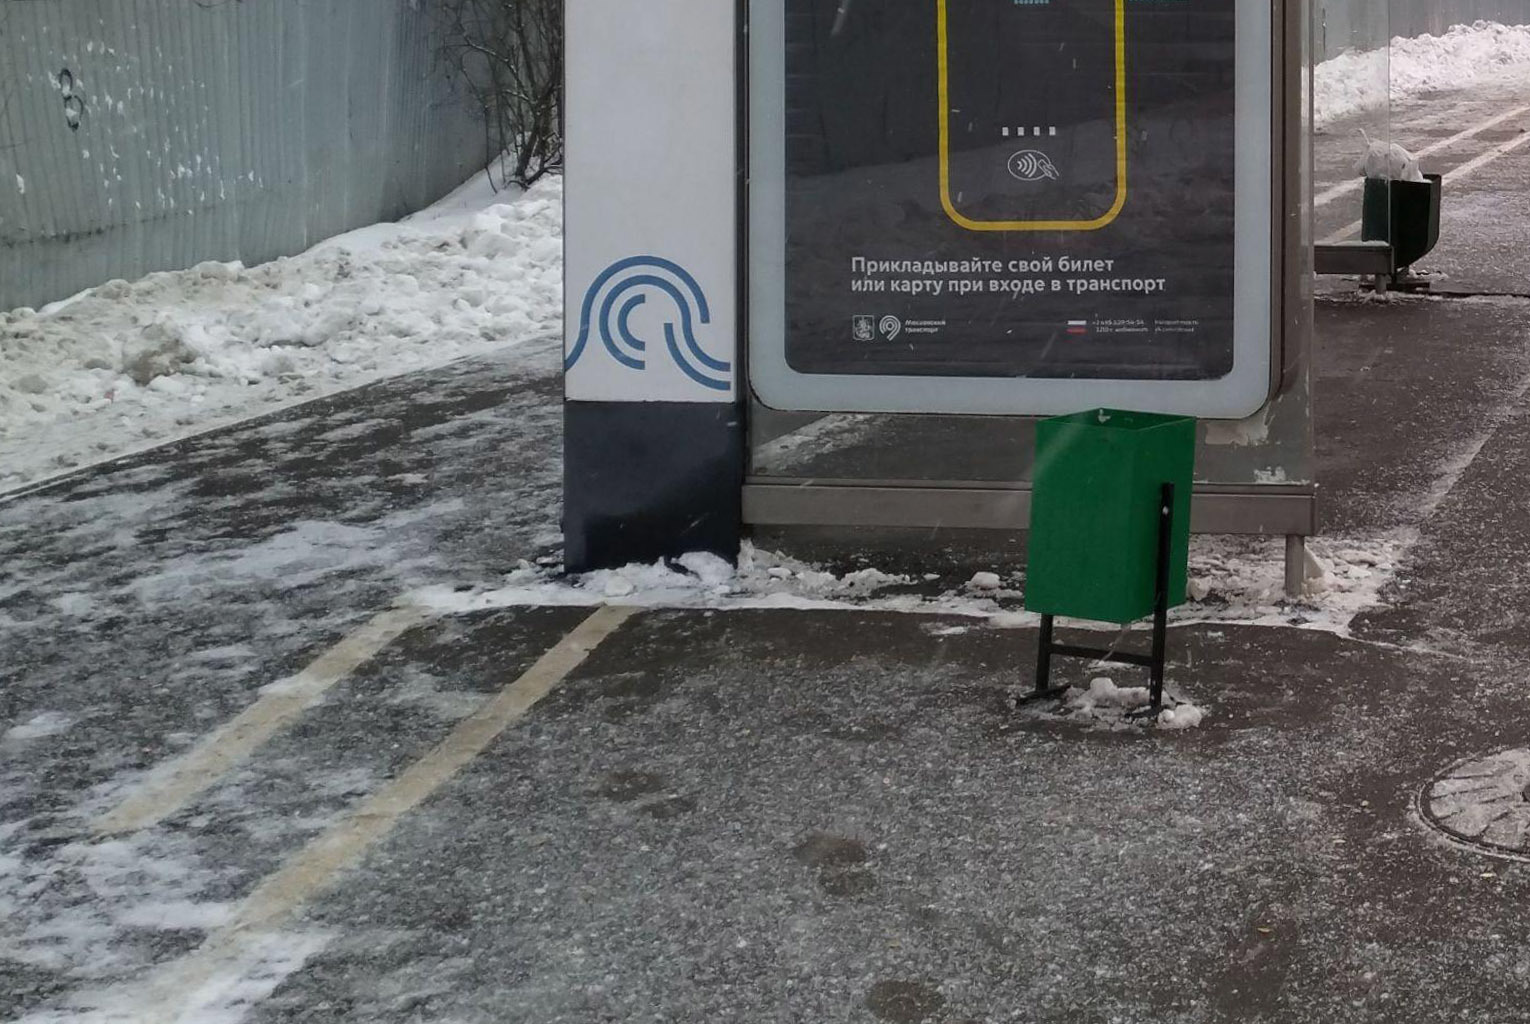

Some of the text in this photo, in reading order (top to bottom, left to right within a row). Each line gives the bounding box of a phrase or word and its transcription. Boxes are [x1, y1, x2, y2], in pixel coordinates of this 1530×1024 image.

[851, 256, 1114, 276] Прикладывайте свой билет
[851, 278, 1166, 296] или карту при входе в транспорт
